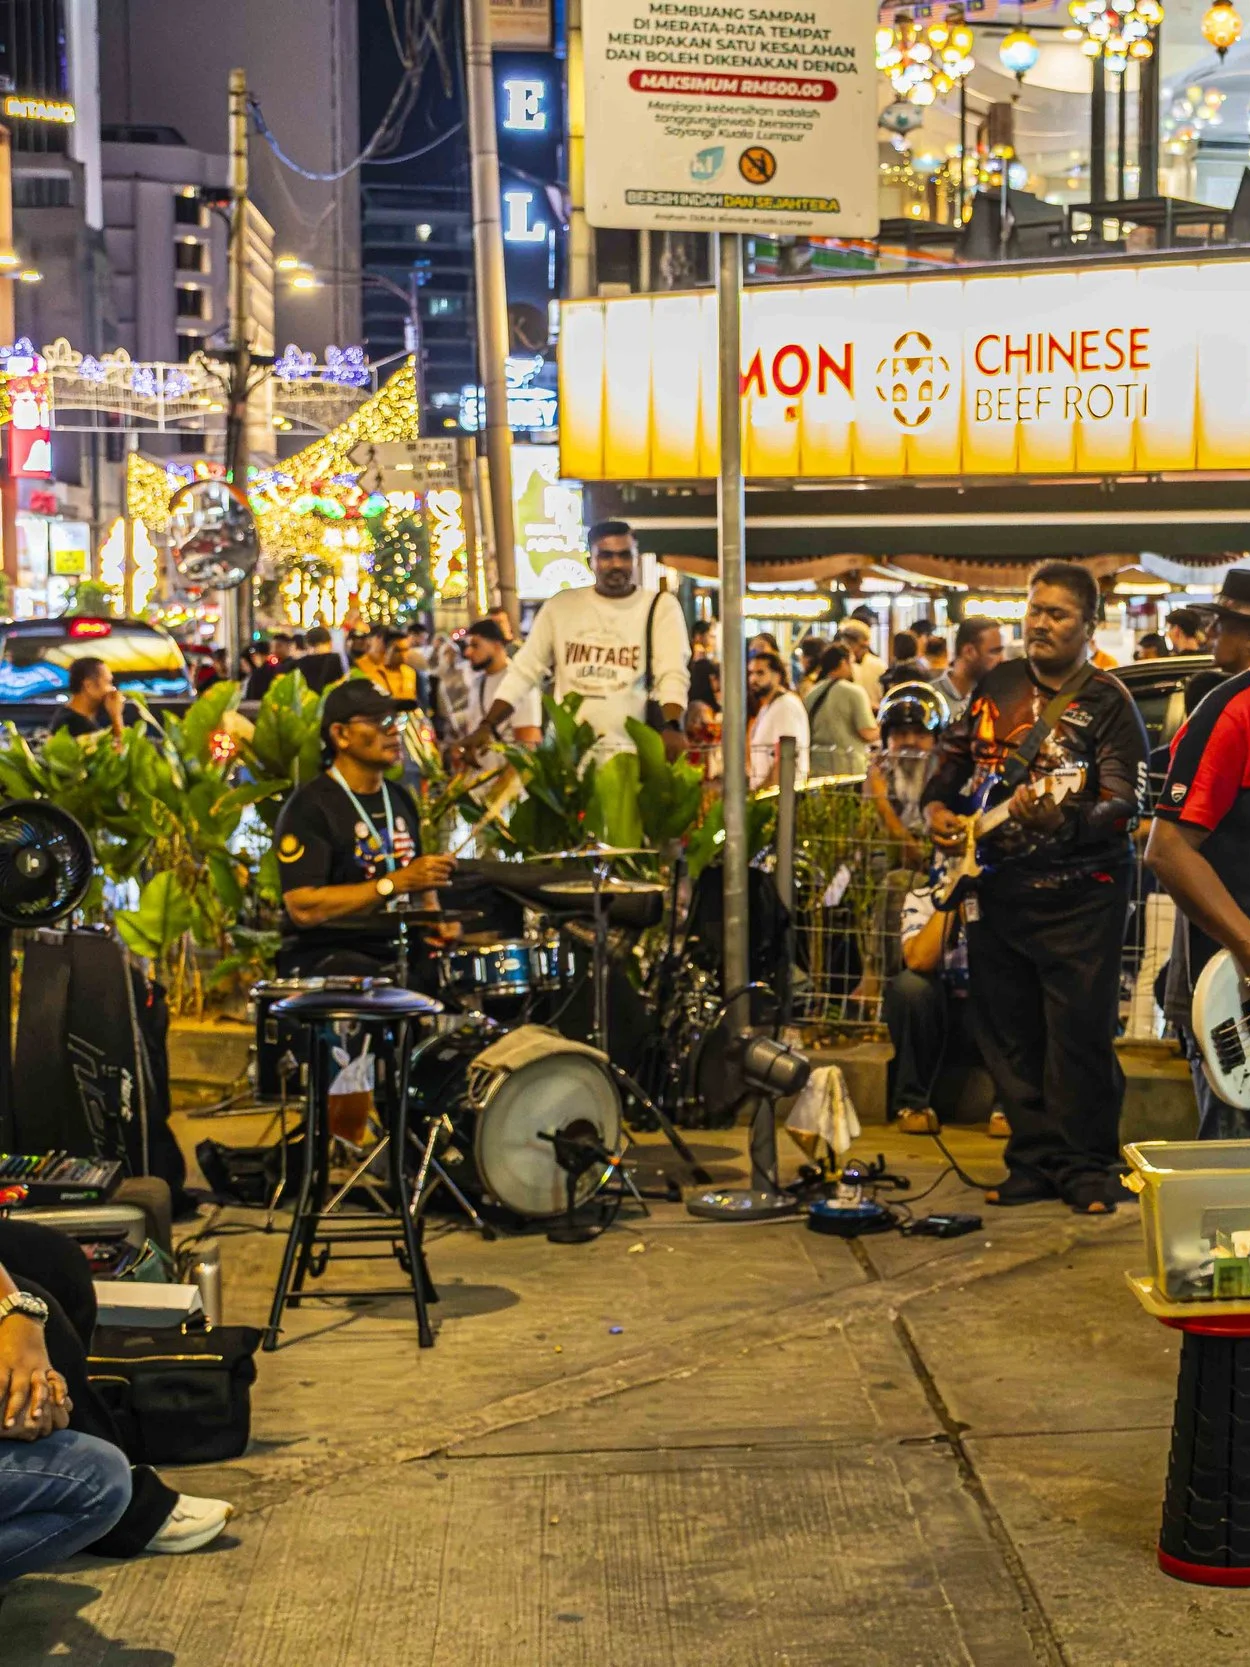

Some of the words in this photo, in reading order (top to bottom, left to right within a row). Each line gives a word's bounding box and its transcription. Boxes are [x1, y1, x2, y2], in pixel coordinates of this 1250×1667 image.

[649, 3, 744, 19] MEMBUANG
[748, 9, 816, 24] SAMPAH
[633, 18, 650, 30] DI
[655, 20, 766, 37] MERATA-RATA
[770, 26, 831, 40] TEMPAT
[608, 32, 711, 49] MERUPAKAN
[716, 38, 756, 52] SATU
[760, 41, 855, 57] KESALAHAN
[605, 48, 640, 61] DAN
[645, 50, 700, 64] BOLEH
[703, 54, 798, 70] DIKENAKAN
[803, 59, 858, 74] DENDA
[639, 73, 739, 93] MAKSIMUM
[741, 79, 825, 98] RM500.00
[974, 327, 1150, 375] CHINESE
[975, 387, 1052, 422] BEEF
[1064, 383, 1148, 420] ROTI
[565, 641, 640, 671] VINTAGE
